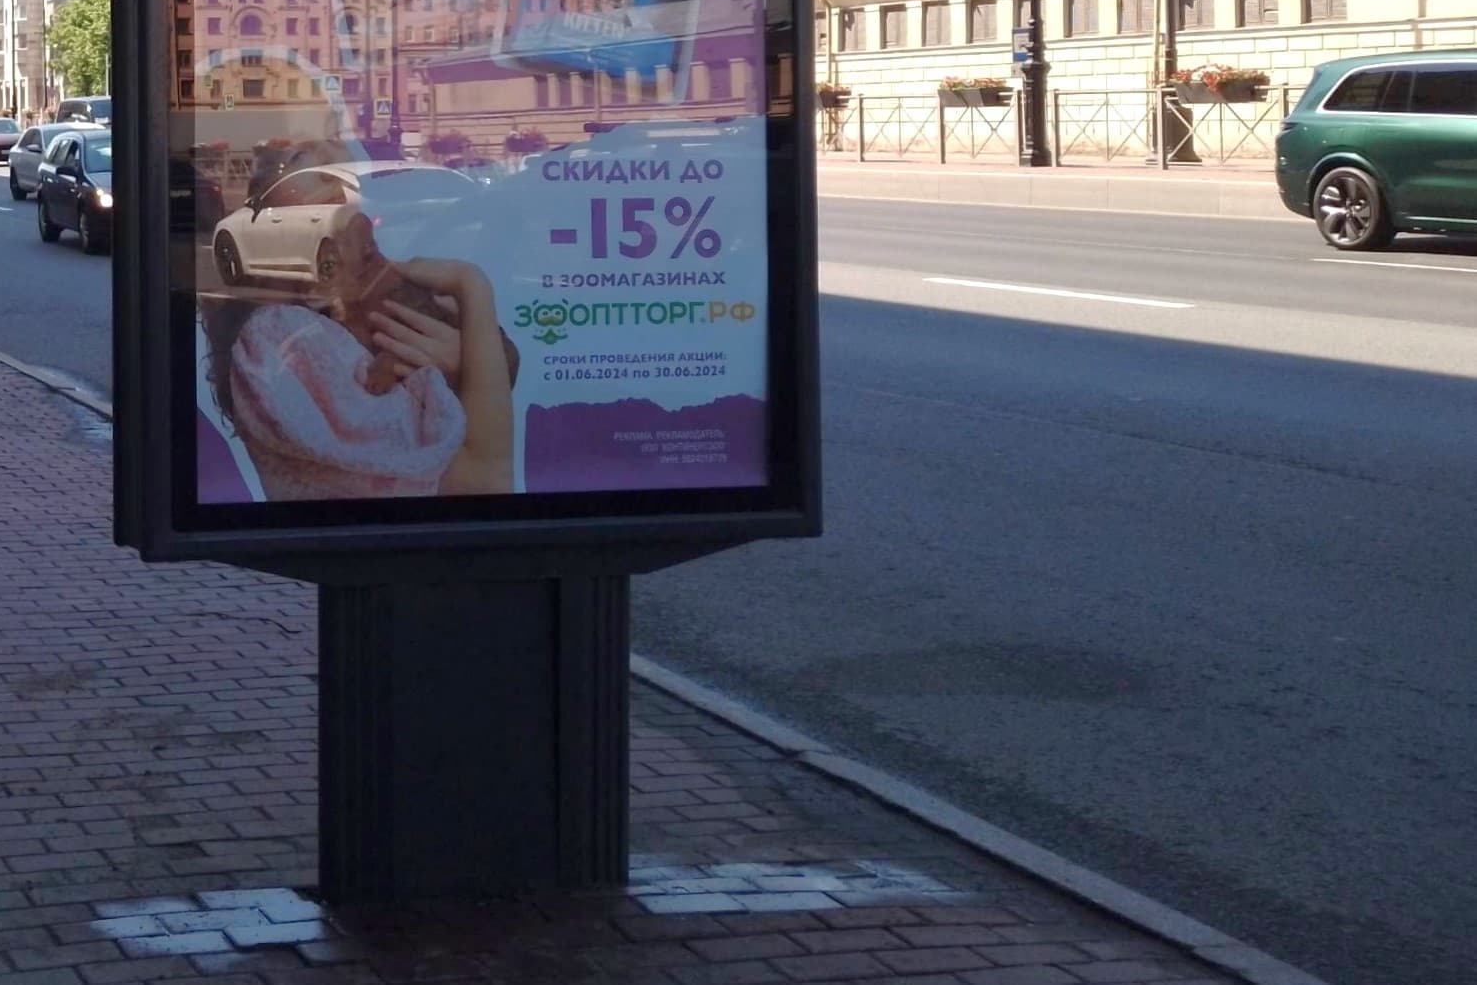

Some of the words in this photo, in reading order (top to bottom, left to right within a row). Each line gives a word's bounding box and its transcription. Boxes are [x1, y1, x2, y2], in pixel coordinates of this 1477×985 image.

[542, 159, 671, 184] СКИДКИ
[679, 159, 724, 183] ДО
[550, 196, 721, 258] -15%
[560, 271, 726, 288] ЗООМАГАЗИНАХ
[544, 355, 586, 365] СРОКИ
[590, 353, 675, 365] ПРОВЕДЕНИЯ
[555, 368, 628, 381] 01.06.2024
[633, 369, 650, 380] по
[654, 365, 726, 379] 30.06.2024
